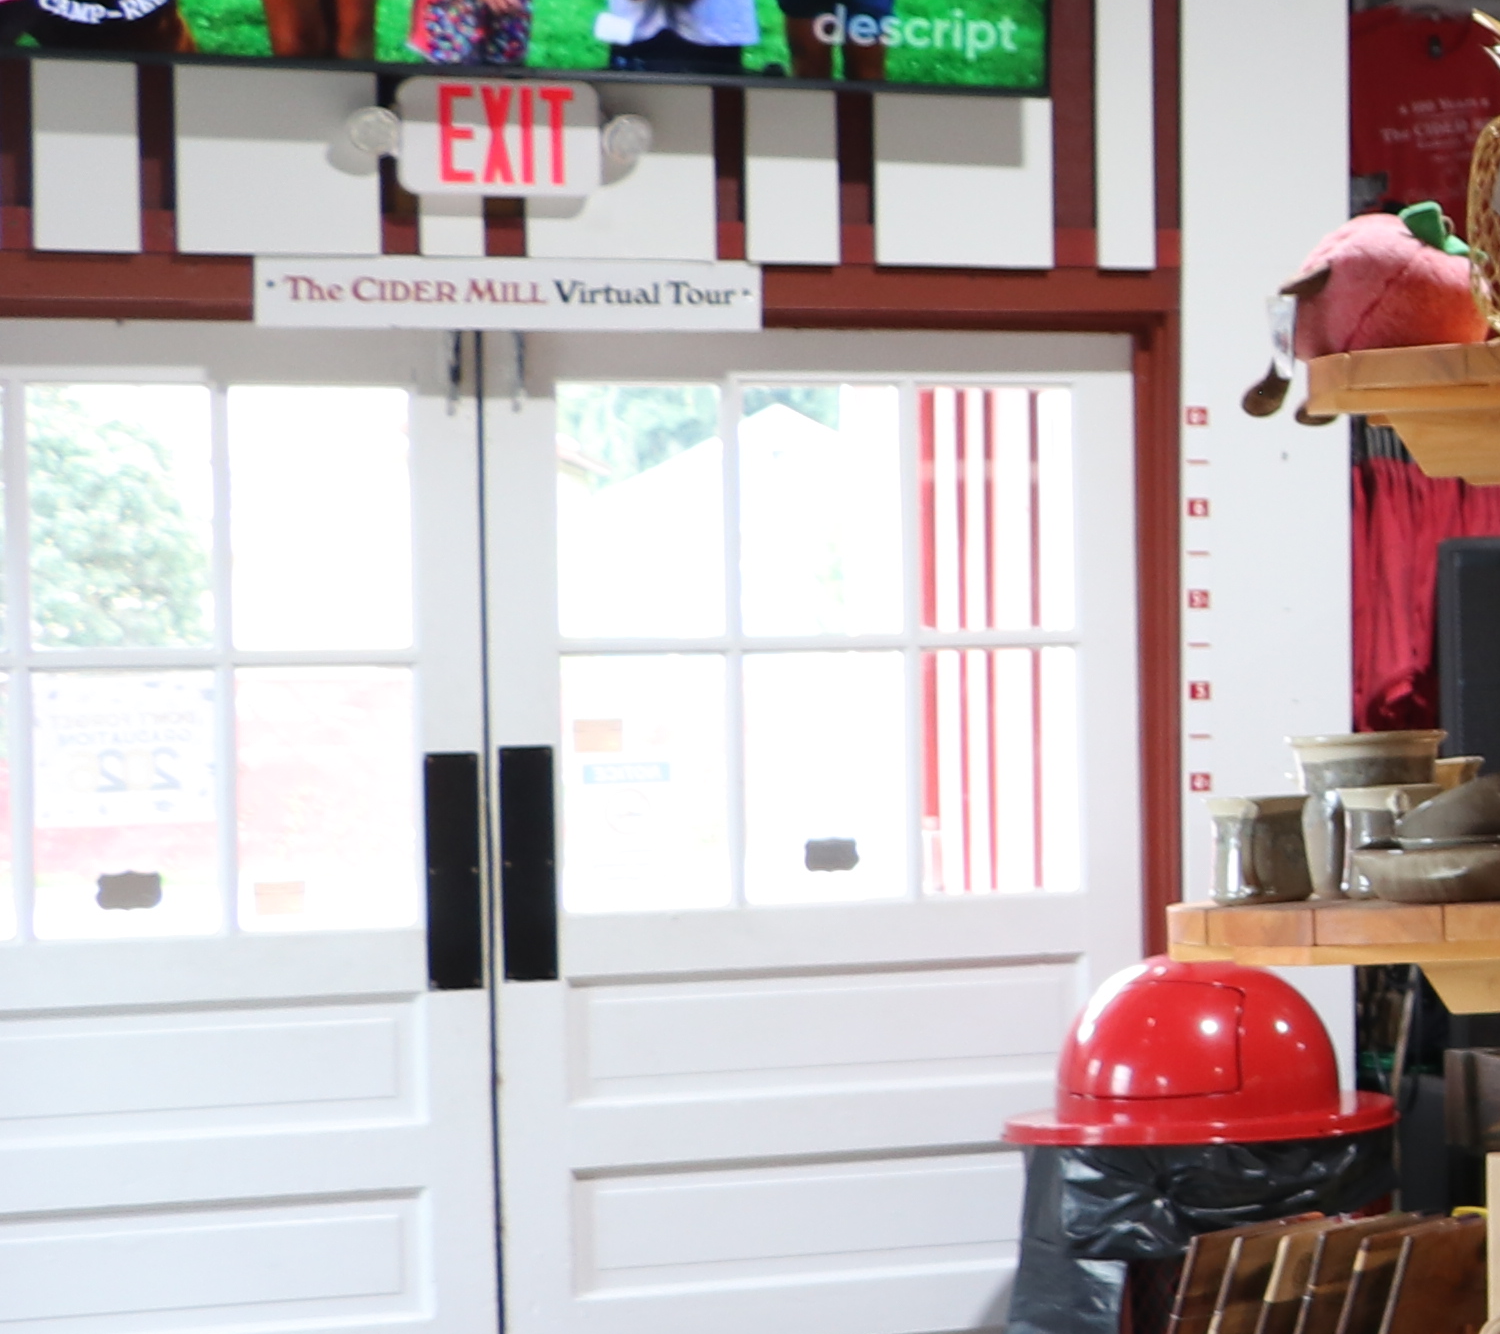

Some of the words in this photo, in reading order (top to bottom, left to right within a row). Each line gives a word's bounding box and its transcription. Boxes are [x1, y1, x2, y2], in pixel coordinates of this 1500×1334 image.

[813, 3, 1017, 59] descript
[439, 84, 573, 185] EXIT
[284, 275, 343, 303] The
[350, 278, 456, 304] CIDER
[465, 279, 546, 305] MILL
[553, 280, 660, 306] Virtual
[666, 281, 738, 306] Tour
